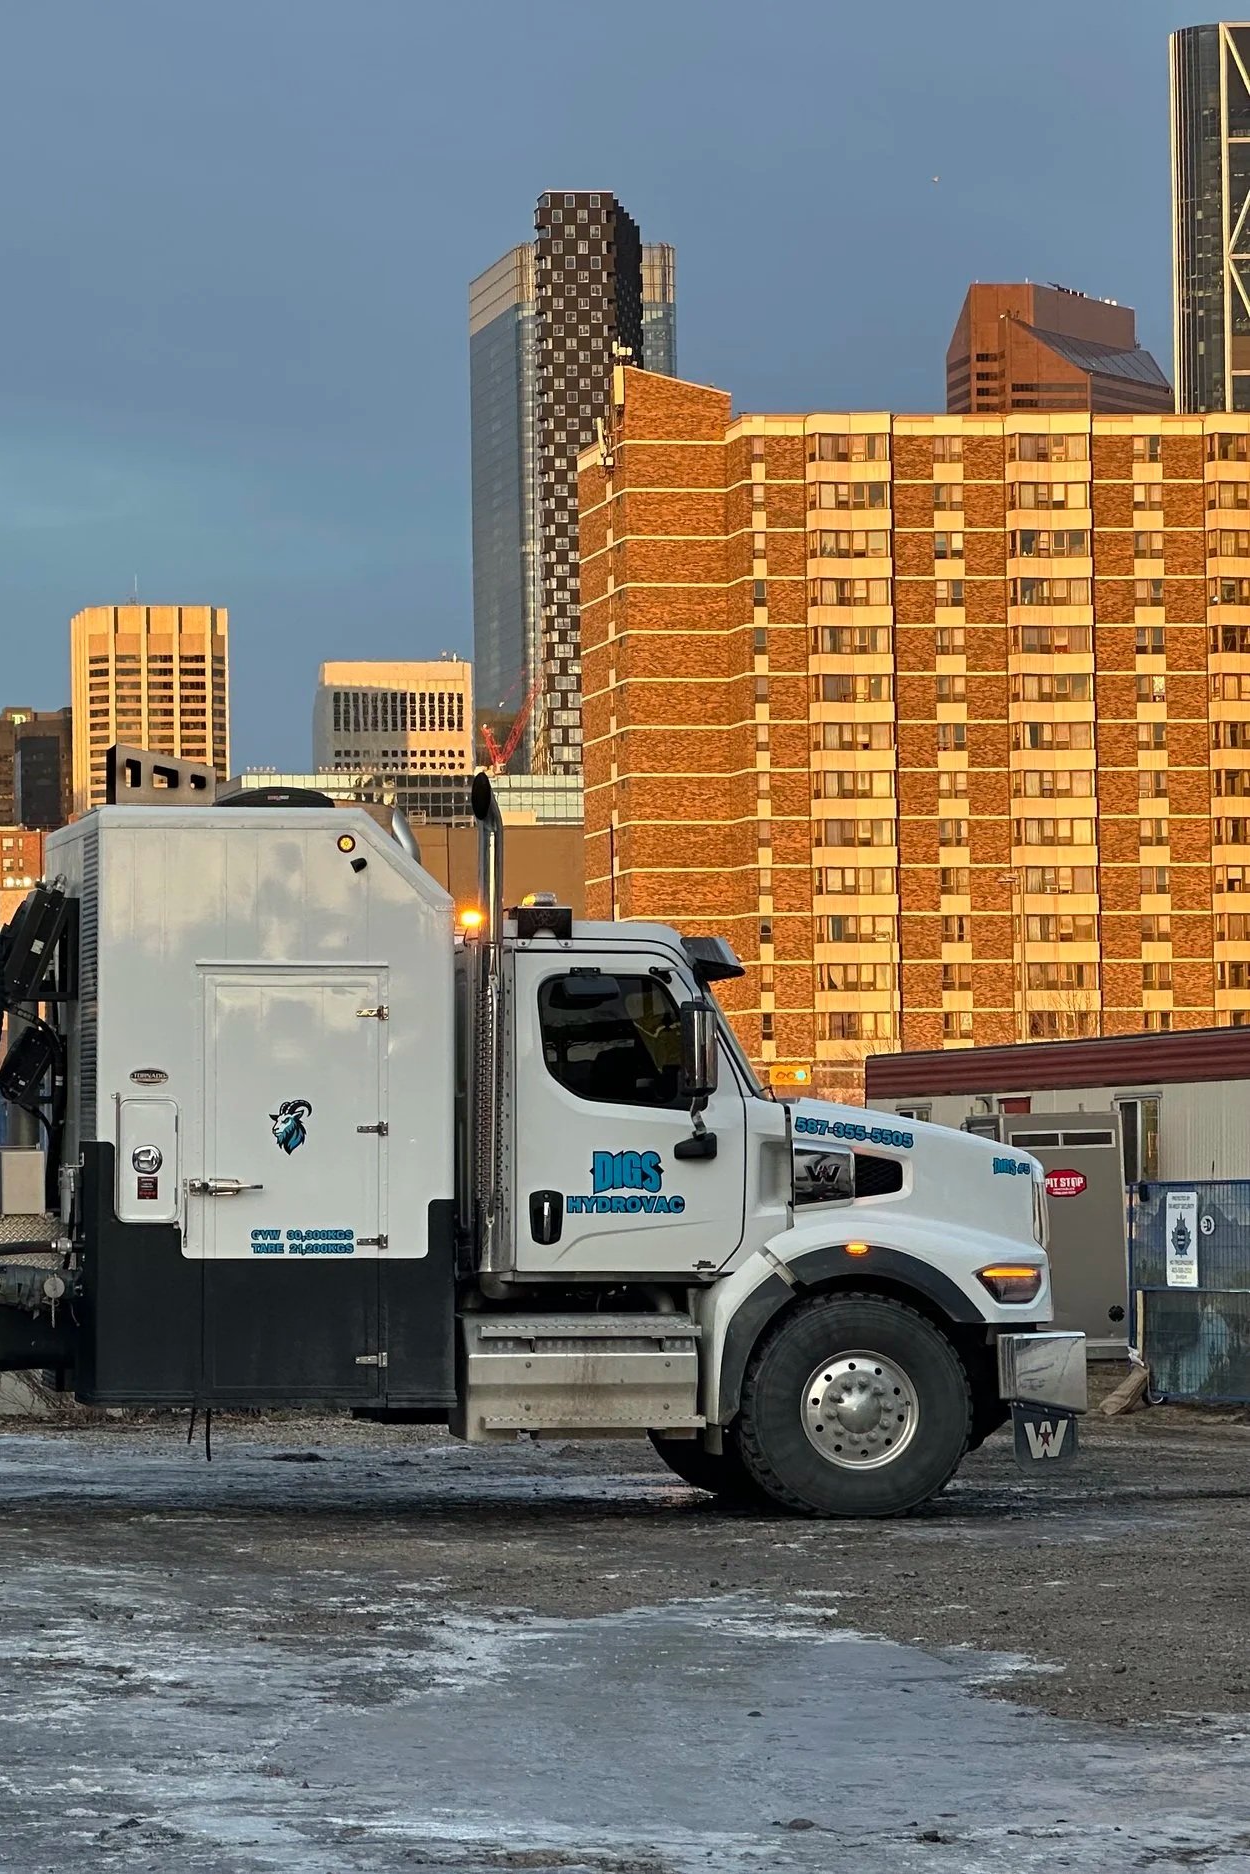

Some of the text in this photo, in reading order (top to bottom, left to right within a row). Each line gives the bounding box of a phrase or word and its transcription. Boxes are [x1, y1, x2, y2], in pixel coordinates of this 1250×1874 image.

[12, 714, 26, 724] TD
[795, 1117, 914, 1148] 587-355-5505
[593, 1151, 662, 1195] DIGS
[993, 1158, 1030, 1176] DIGS #5
[1045, 1177, 1084, 1188] PIT STOP
[566, 1196, 685, 1213] HYDROVAC
[251, 1230, 354, 1242] GVW 30,300KGS
[251, 1243, 354, 1255] TARE 21,200KGS
